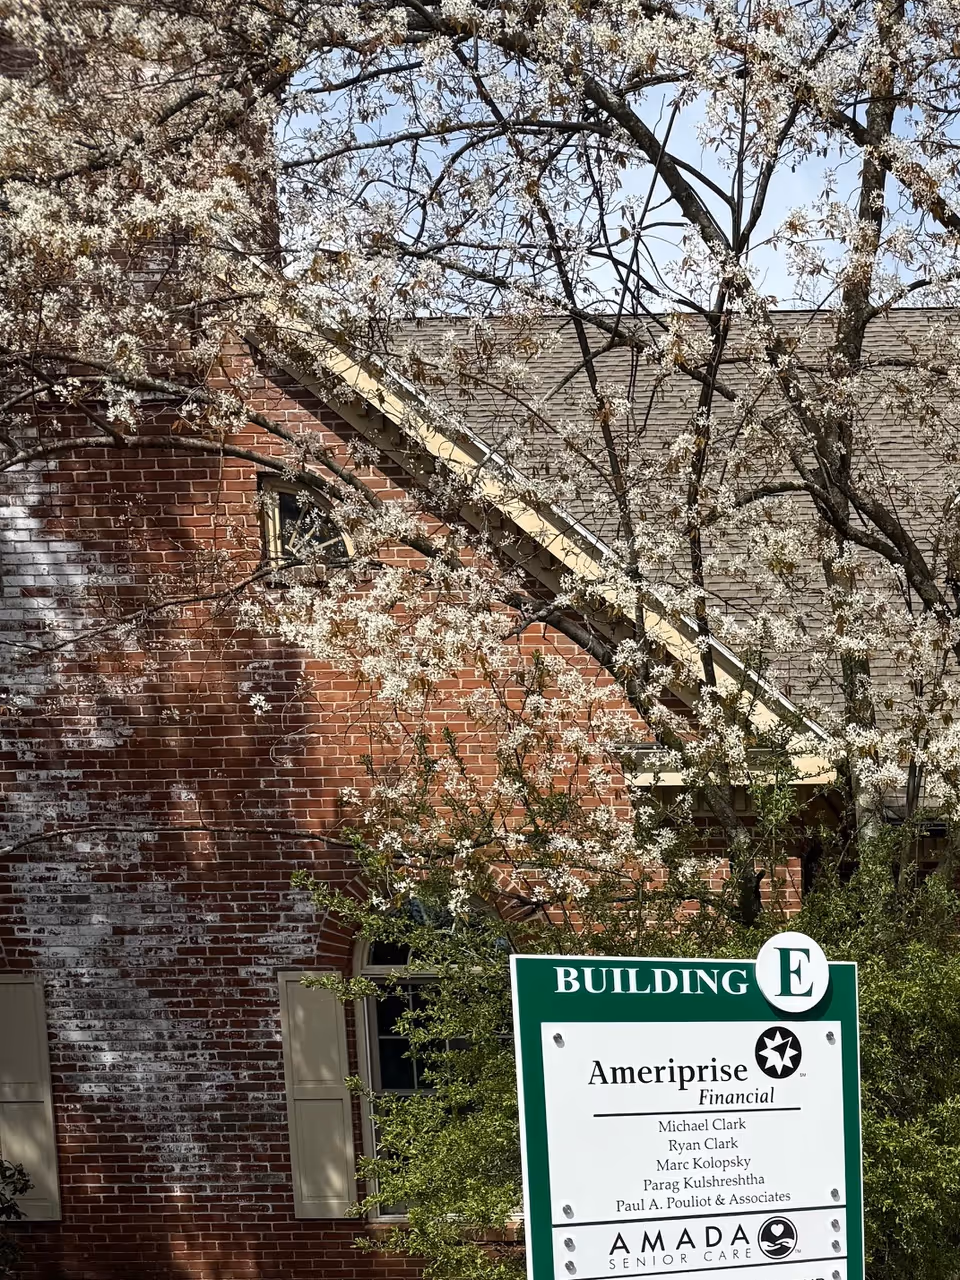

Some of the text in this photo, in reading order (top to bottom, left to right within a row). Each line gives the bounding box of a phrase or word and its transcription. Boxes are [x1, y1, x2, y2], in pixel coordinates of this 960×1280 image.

[552, 948, 814, 997] BUILDING E
[588, 1058, 748, 1090] Ameriprise
[698, 1087, 775, 1106] Financial
[658, 1118, 747, 1133] Michael Clark
[668, 1137, 739, 1156] Ryan Clark
[656, 1156, 752, 1172] Marc Kolopsky
[643, 1174, 765, 1194] Parag Kulshreshtha
[616, 1192, 791, 1213] Paul A. Pouliot & Associates
[609, 1223, 750, 1256] AMADA
[609, 1247, 752, 1270] SENIOR CARE
